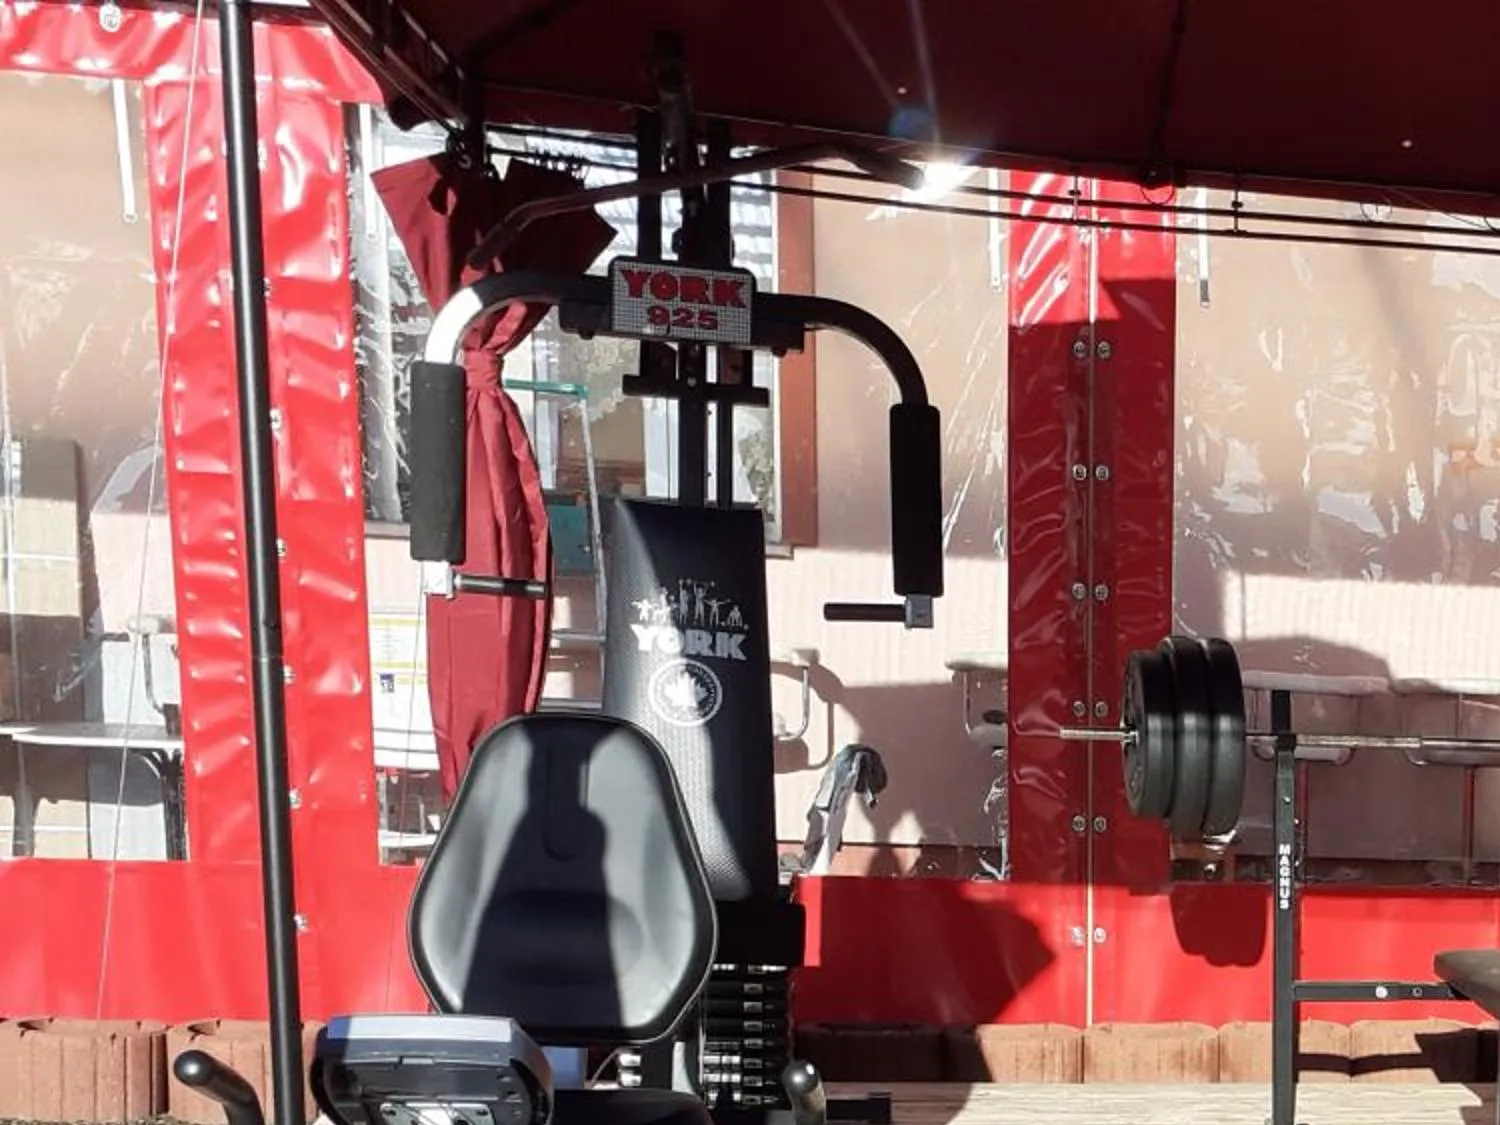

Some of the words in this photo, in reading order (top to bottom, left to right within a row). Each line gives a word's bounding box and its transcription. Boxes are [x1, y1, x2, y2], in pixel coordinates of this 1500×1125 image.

[621, 269, 747, 308] YORK
[646, 305, 719, 330] 925
[630, 623, 748, 661] YORK
[1279, 843, 1291, 909] MAGNUS
